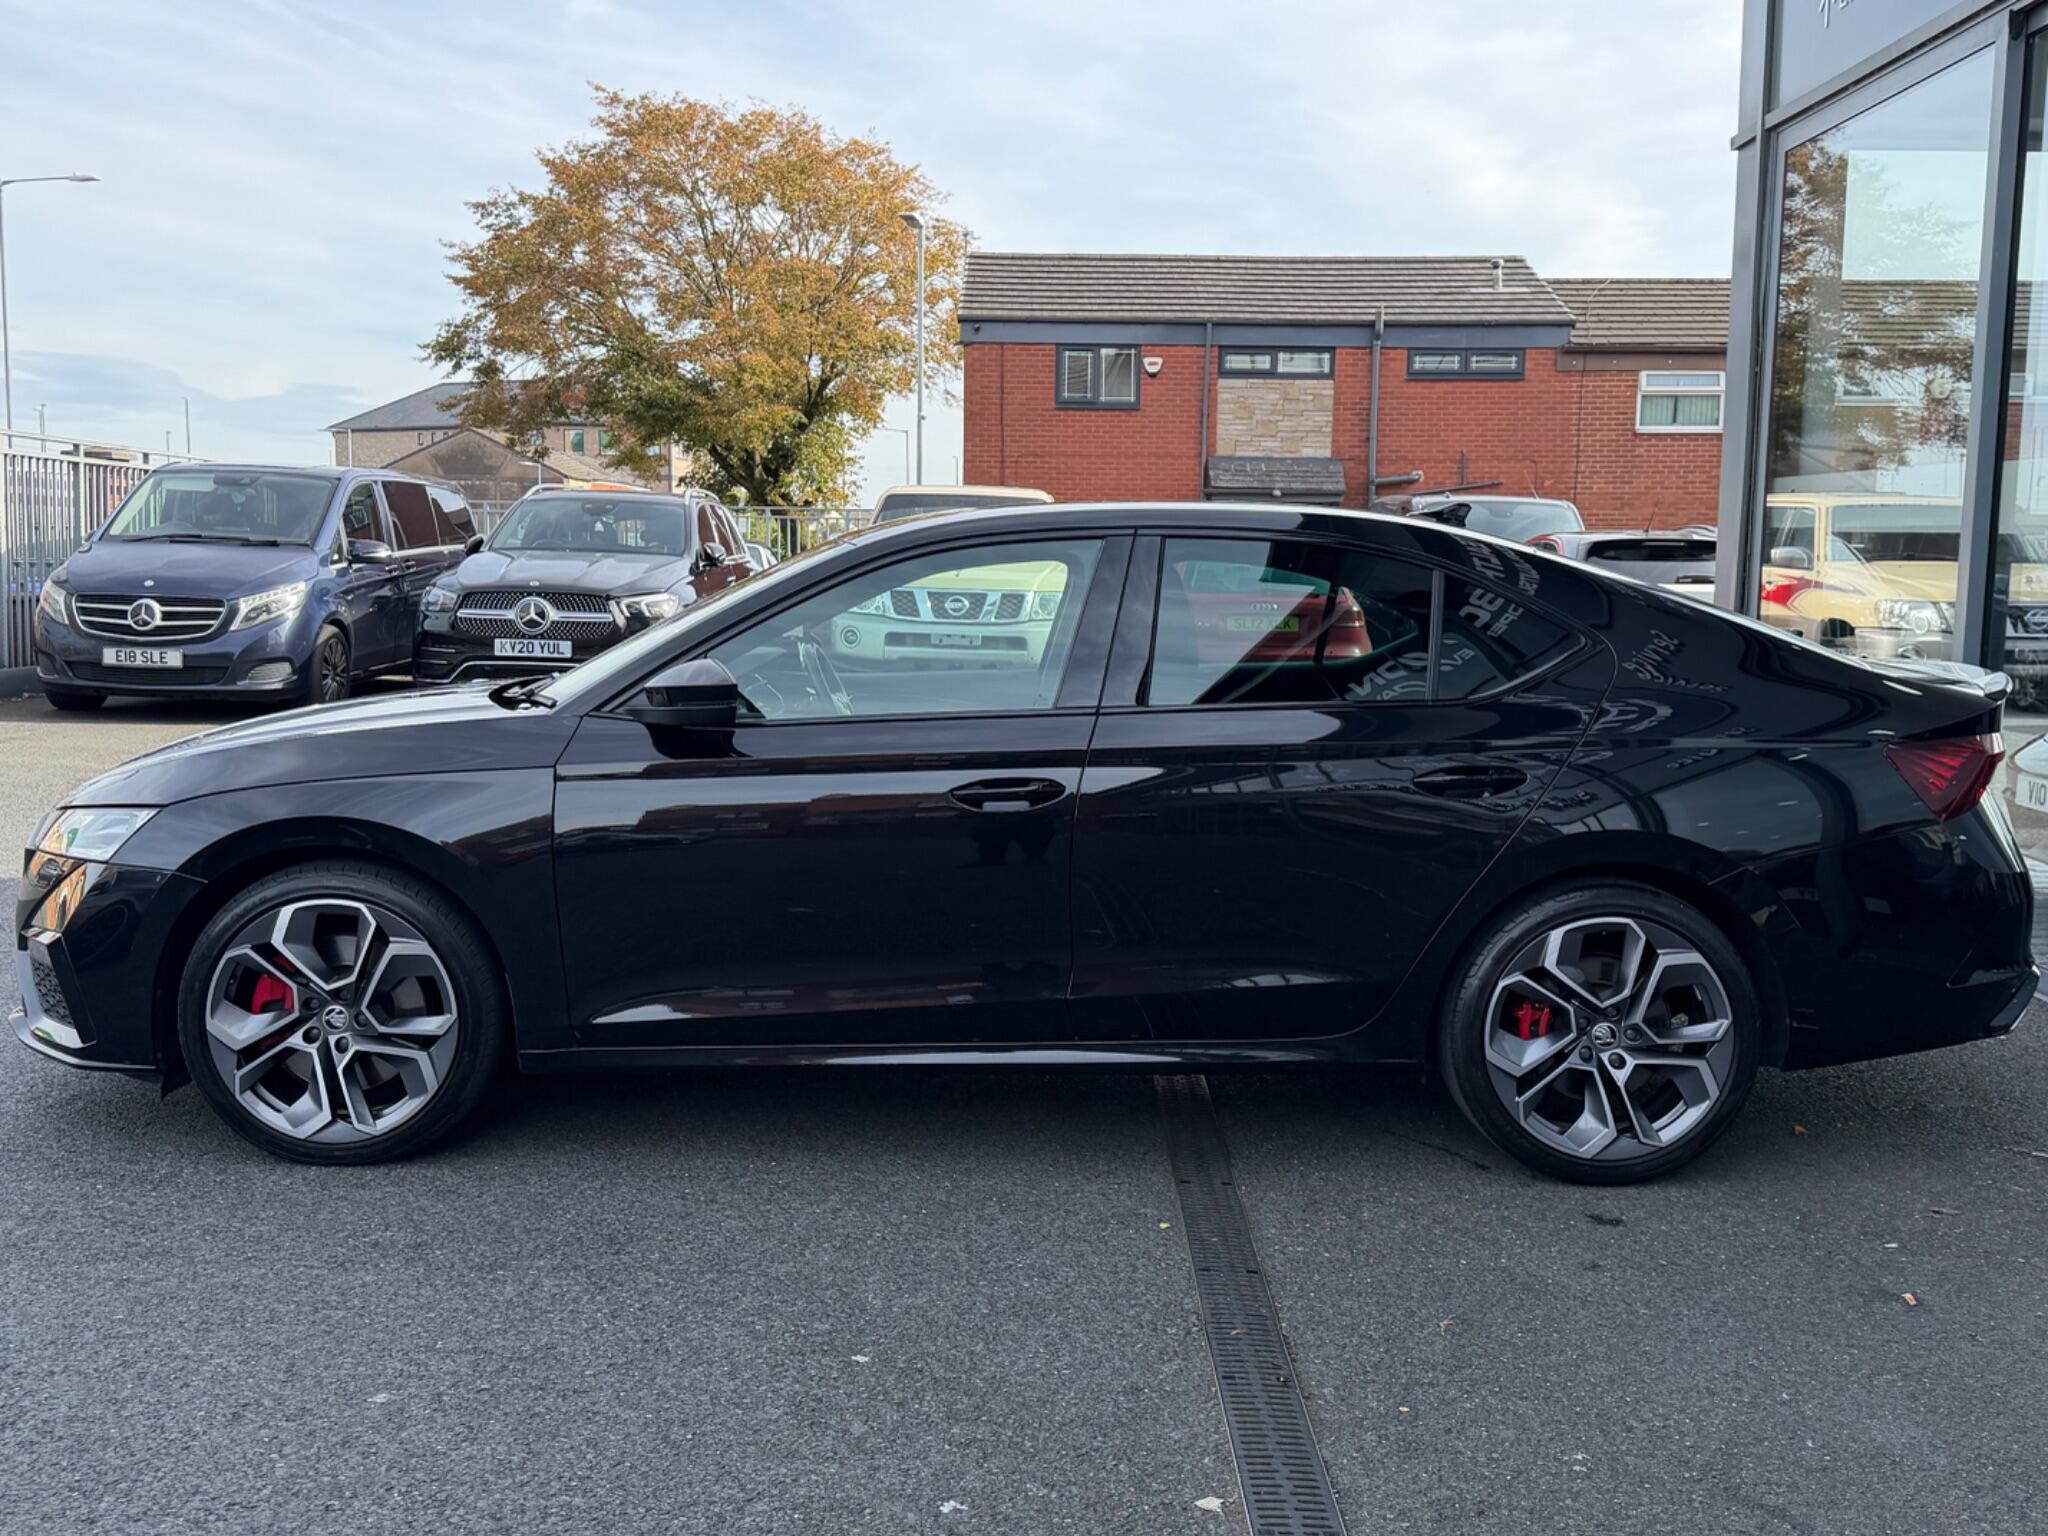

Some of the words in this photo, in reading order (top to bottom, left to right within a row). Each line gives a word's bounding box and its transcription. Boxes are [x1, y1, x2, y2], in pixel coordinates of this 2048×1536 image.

[500, 641, 535, 654] KV20
[539, 642, 566, 655] YUL
[140, 651, 169, 664] SLE
